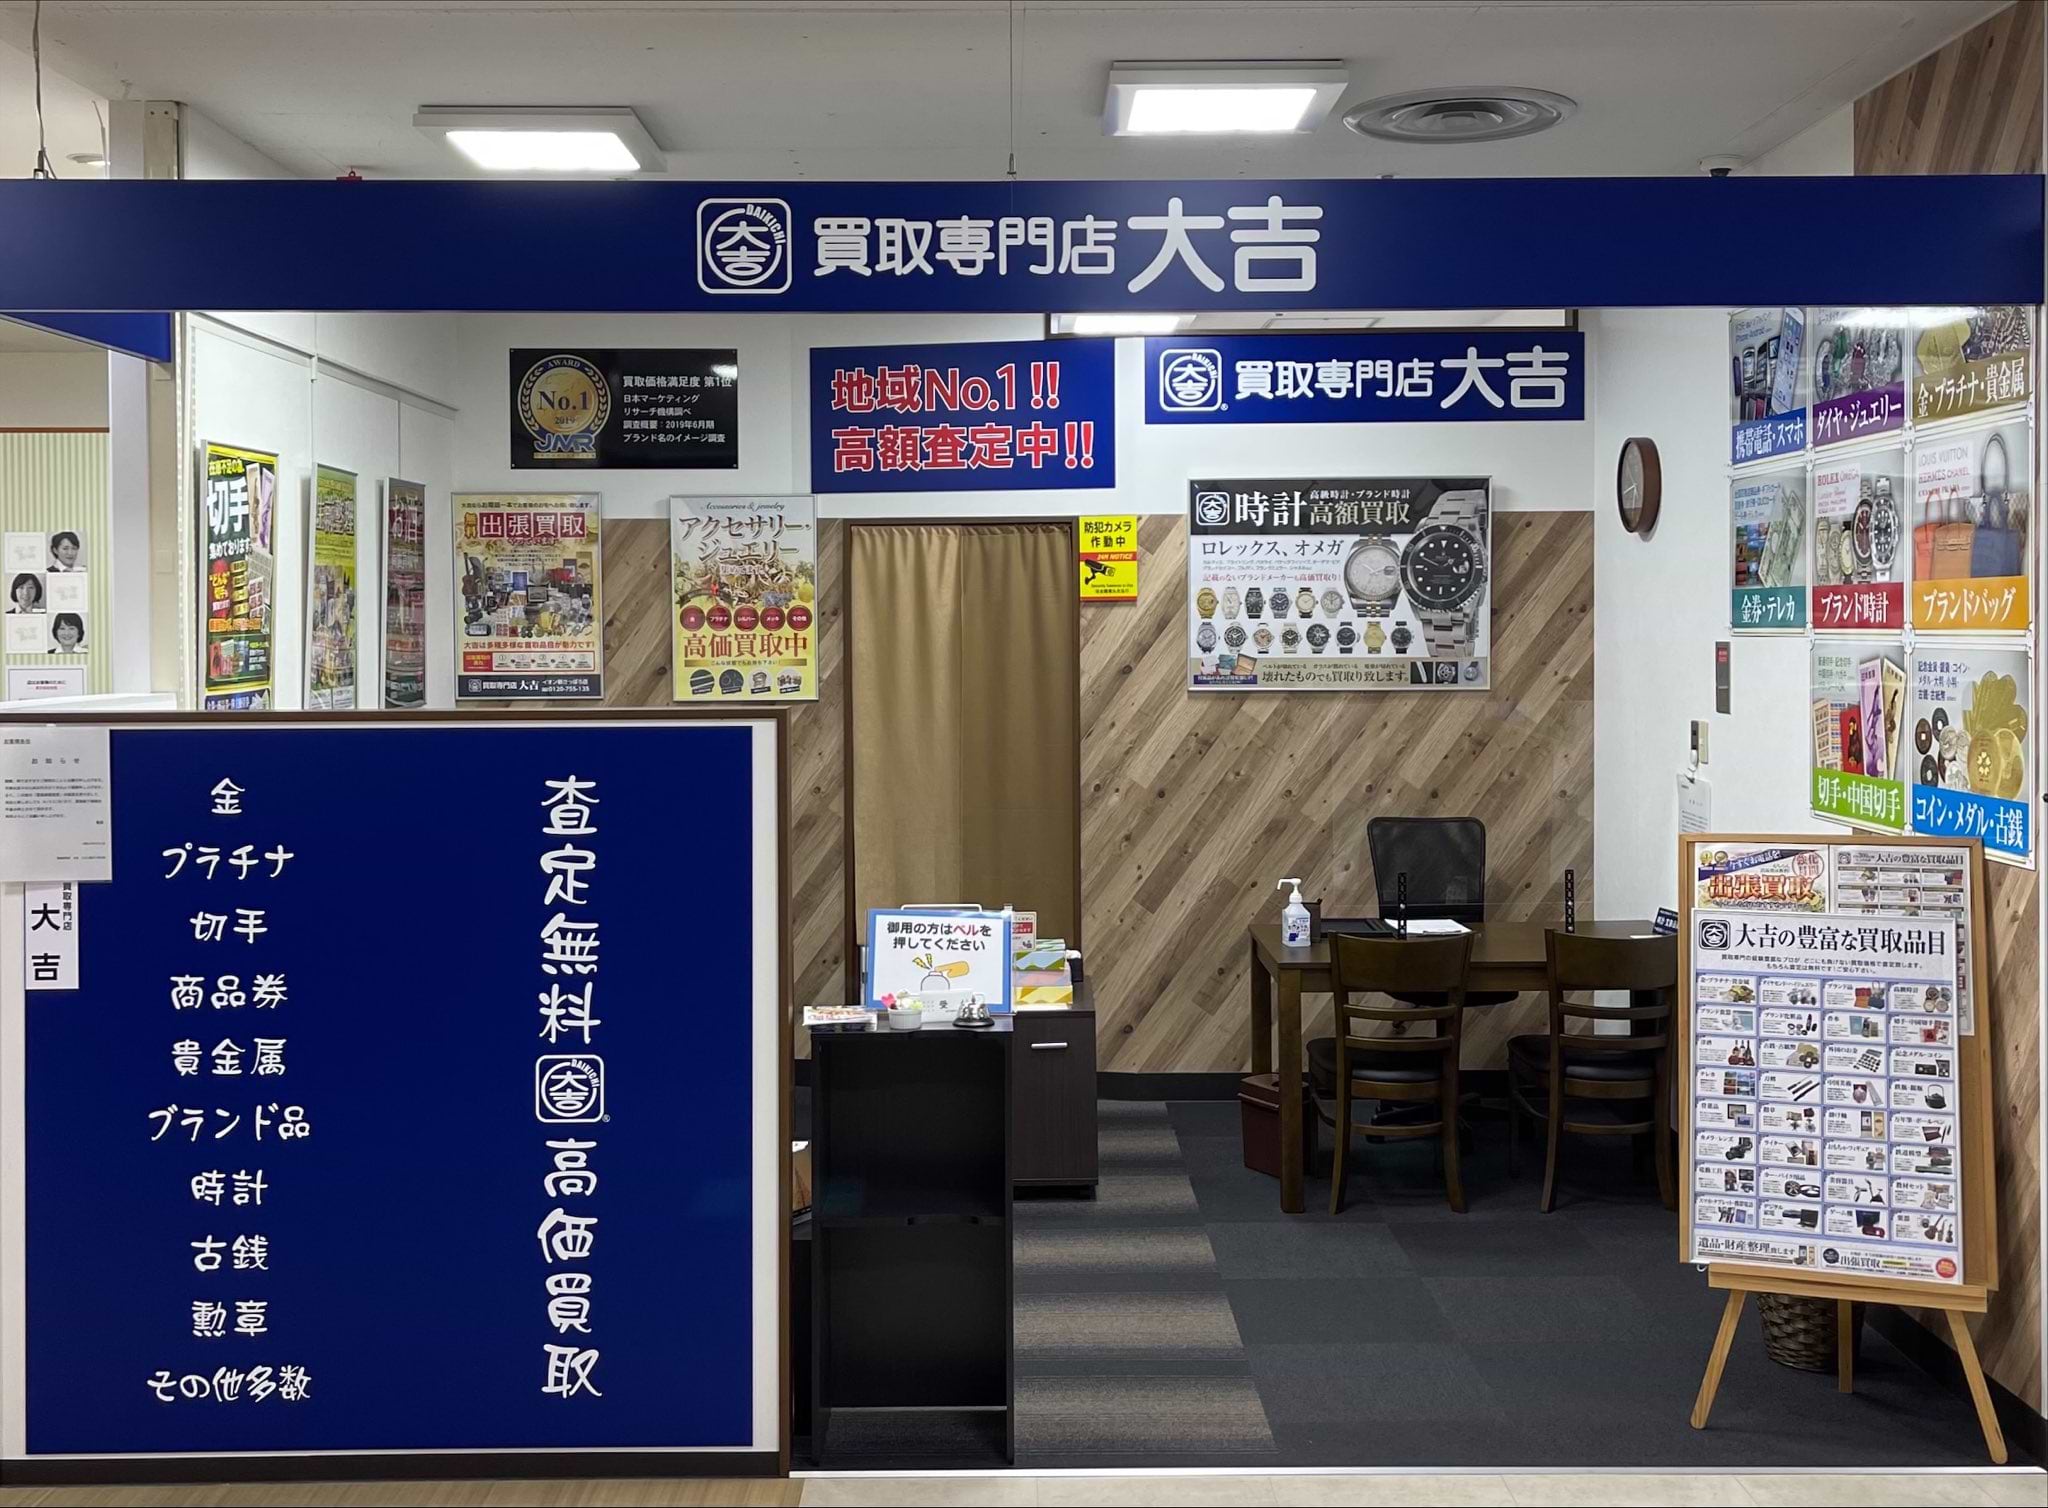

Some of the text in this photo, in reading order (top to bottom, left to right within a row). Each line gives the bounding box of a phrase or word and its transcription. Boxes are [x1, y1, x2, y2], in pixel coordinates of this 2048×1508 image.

[746, 204, 786, 244] DAIKICHI
[813, 195, 1324, 293] 買取専門店 大吉
[547, 358, 581, 369] AWARD
[1235, 345, 1570, 409] 買取専門店 大吉
[622, 375, 733, 388] 買取価格満足度 第1位
[623, 394, 700, 403] 日本マーケティング
[1917, 357, 2025, 418] 金・プラチナ・貴金属
[537, 389, 591, 412] No.1
[623, 407, 692, 416] リサーチ機構調べ
[1816, 393, 1901, 440] ダイヤ・ジュエリー
[554, 416, 576, 425] 2019
[533, 432, 597, 453] JMR
[623, 433, 726, 443] ブランド名のイメージ調査
[831, 420, 1095, 473] 高額査定中!!
[1736, 420, 1804, 459] 携帯電話・スマホ
[207, 477, 249, 536] 切手
[1235, 491, 1308, 527] 時計
[1309, 489, 1411, 500] 高級時計・ブランド時計
[482, 513, 584, 536] 出張買取
[1084, 521, 1132, 534] 防犯カメラ
[1309, 500, 1411, 526] 高額買取
[698, 538, 800, 562] ジュエリー
[1202, 539, 1345, 557] ロレックス、オメガ
[1741, 593, 1796, 624] 金券・テレカ
[1821, 591, 1889, 623] ブランド時計
[1923, 587, 2017, 623] ブランドバッグ
[684, 632, 808, 658] 高価買取中
[519, 680, 540, 690] 大吉
[1262, 670, 1409, 683] 壊れたものでも買取り致します。
[211, 777, 245, 815] 金
[1818, 775, 1901, 823] 切手・中国切手
[1916, 794, 2024, 848] コイン・メダル・古銭
[162, 842, 294, 879] プラチナ
[1876, 853, 1964, 865] 大吉の豊富な買取品目
[1708, 873, 1817, 900] 出張買取
[190, 908, 268, 943] 切手
[538, 775, 601, 1044] 査定無料
[31, 902, 61, 981] 大吉
[887, 921, 992, 937] 御用の方はベルを
[893, 937, 986, 951] 押してください
[1735, 922, 1946, 956] 大吉の豊富な買取品目
[170, 973, 288, 1009] 商品券
[172, 1037, 287, 1076] 貴金属
[571, 1058, 600, 1088] DAIKICHI
[148, 1102, 311, 1142] ブランド品
[191, 1169, 268, 1206] 時計
[191, 1234, 269, 1271] 古銭
[537, 1138, 602, 1398] 高価買取
[191, 1300, 268, 1337] 勲章
[147, 1364, 312, 1402] その他多数
